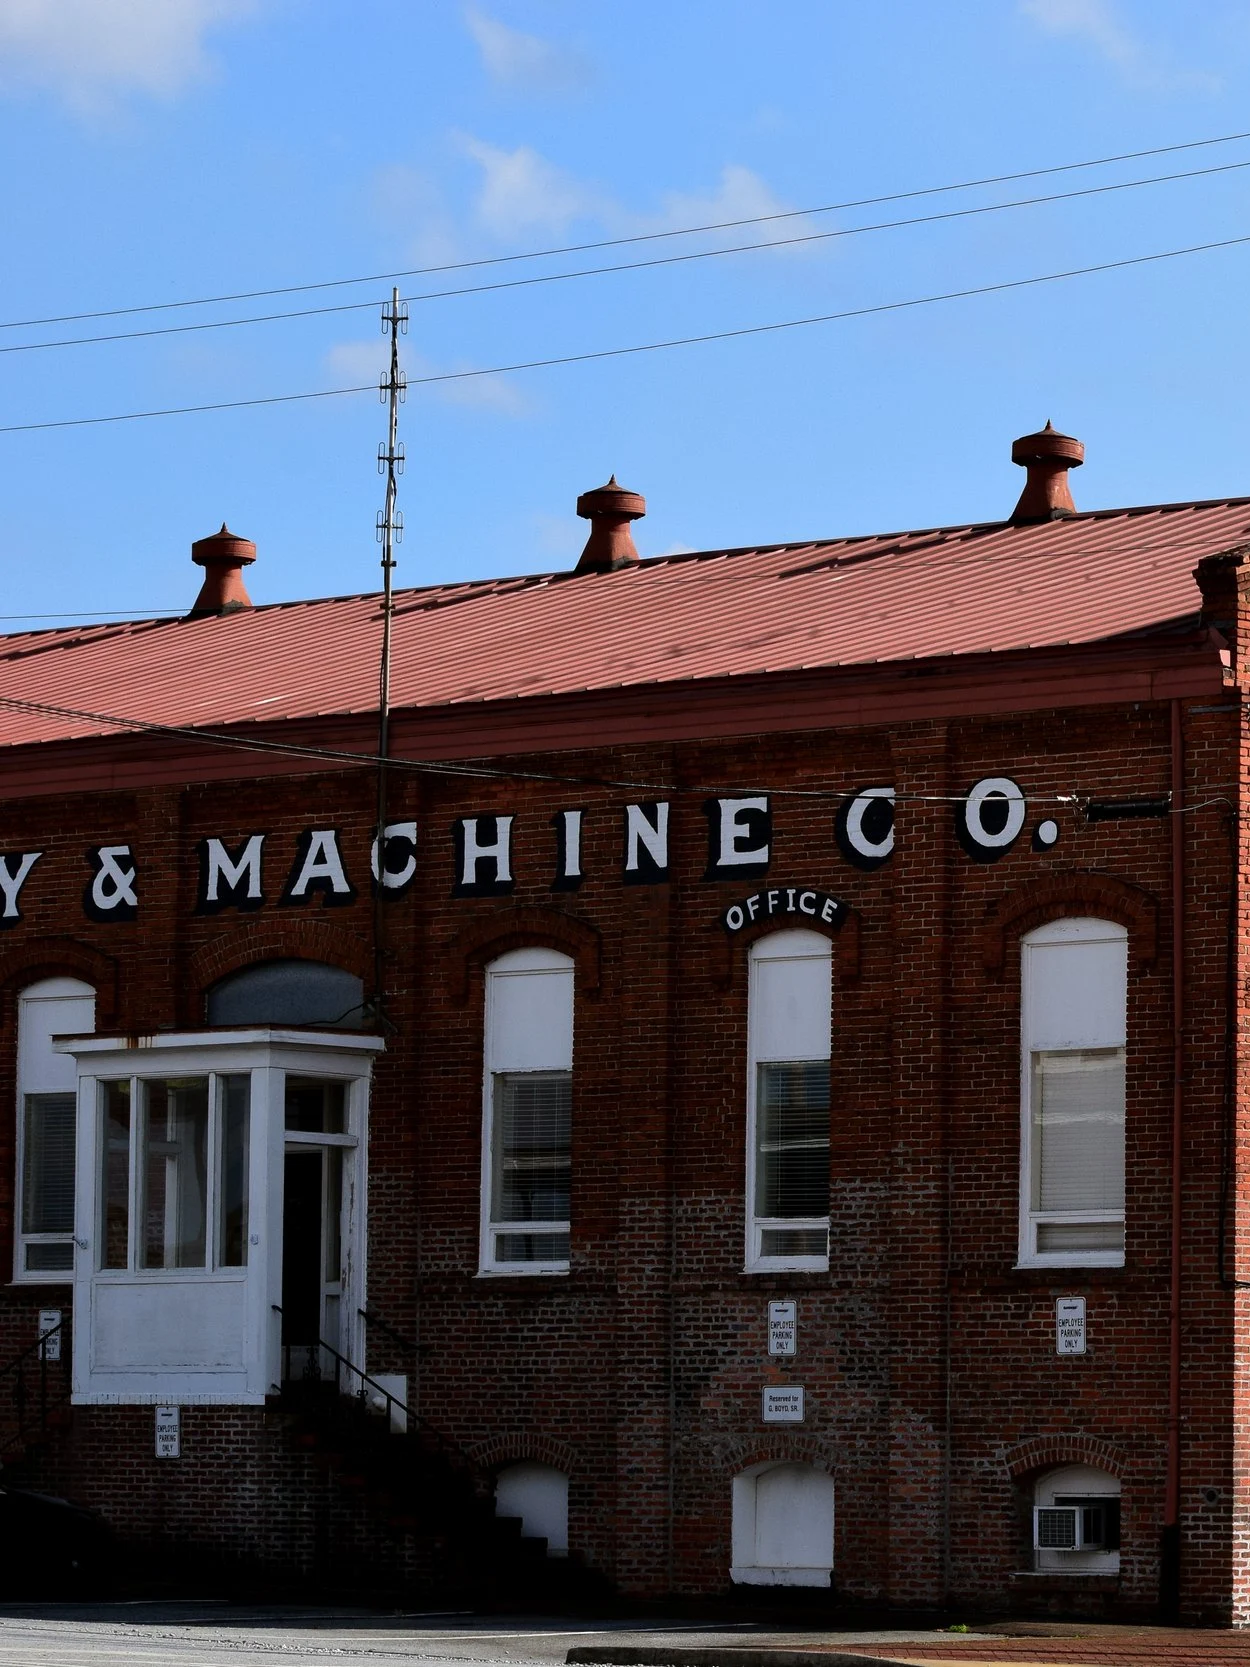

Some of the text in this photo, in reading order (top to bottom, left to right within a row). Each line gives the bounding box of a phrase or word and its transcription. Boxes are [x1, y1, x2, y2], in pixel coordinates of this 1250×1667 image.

[92, 845, 138, 909] &
[205, 796, 769, 901] MACHINE
[846, 777, 1059, 858] CO.
[726, 889, 838, 930] OFFICE
[770, 1321, 794, 1329] EMPLOYEE
[1058, 1318, 1084, 1327] EMPLOYEE
[772, 1331, 793, 1339] PARKING
[1060, 1328, 1082, 1337] PARKING
[776, 1341, 789, 1350] ONLY
[1064, 1339, 1078, 1348] ONLY
[157, 1424, 178, 1433] EMPLOYEE
[159, 1434, 176, 1443] PARKING
